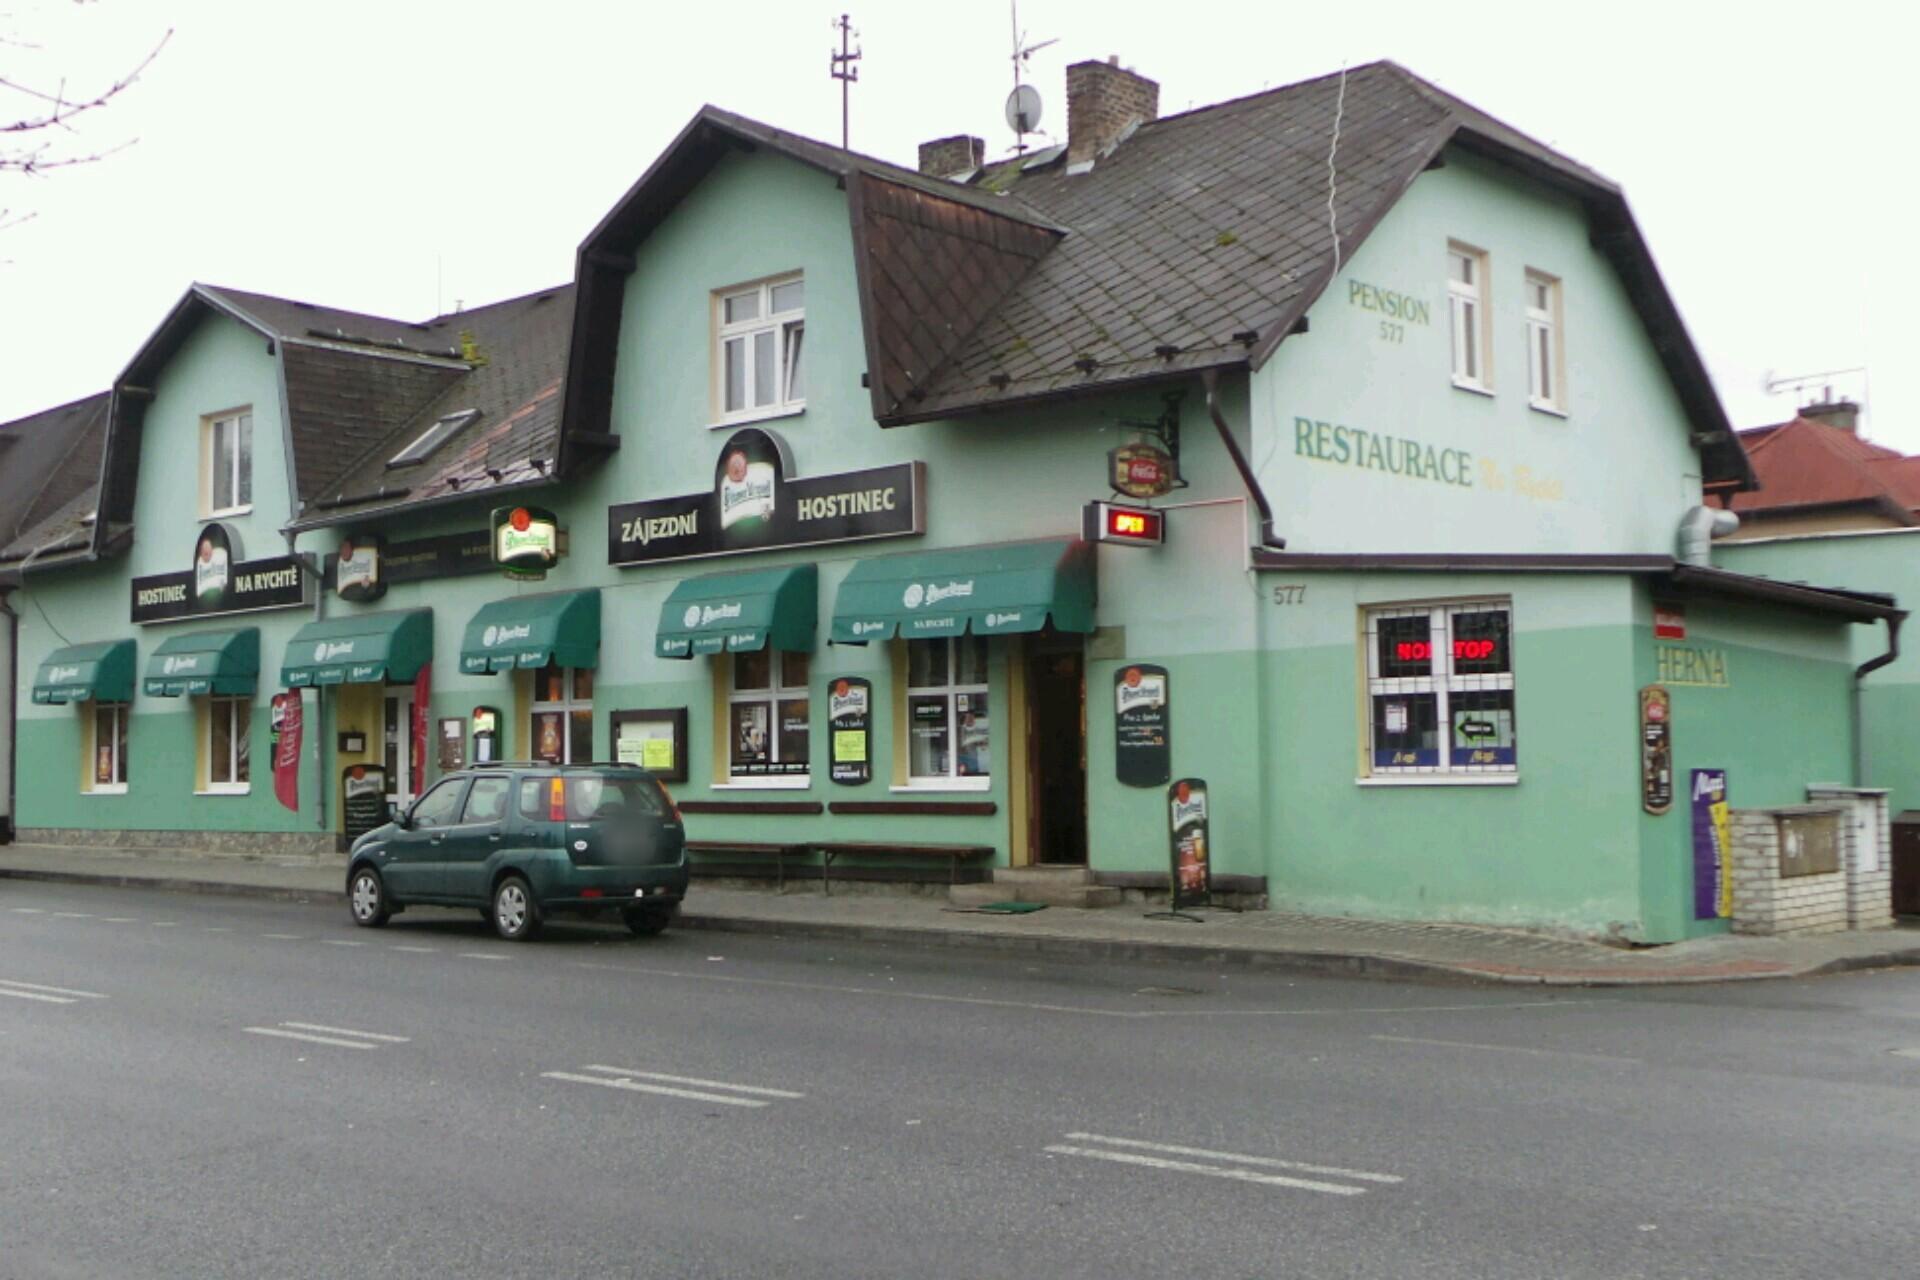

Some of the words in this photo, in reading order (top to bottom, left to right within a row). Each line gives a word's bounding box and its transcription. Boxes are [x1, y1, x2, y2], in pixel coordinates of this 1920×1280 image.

[1349, 280, 1430, 325] PENSION
[1380, 320, 1405, 344] 577
[1294, 417, 1473, 487] RESTAURACE
[621, 509, 698, 546] ZÁJEZDNÍ
[798, 487, 895, 521] HOSTINEC
[137, 584, 187, 606] HOSTINEC
[235, 576, 251, 593] NA
[254, 564, 298, 592] RYCHTĚ
[1273, 584, 1306, 605] 577
[1655, 646, 1730, 686] HERNA
